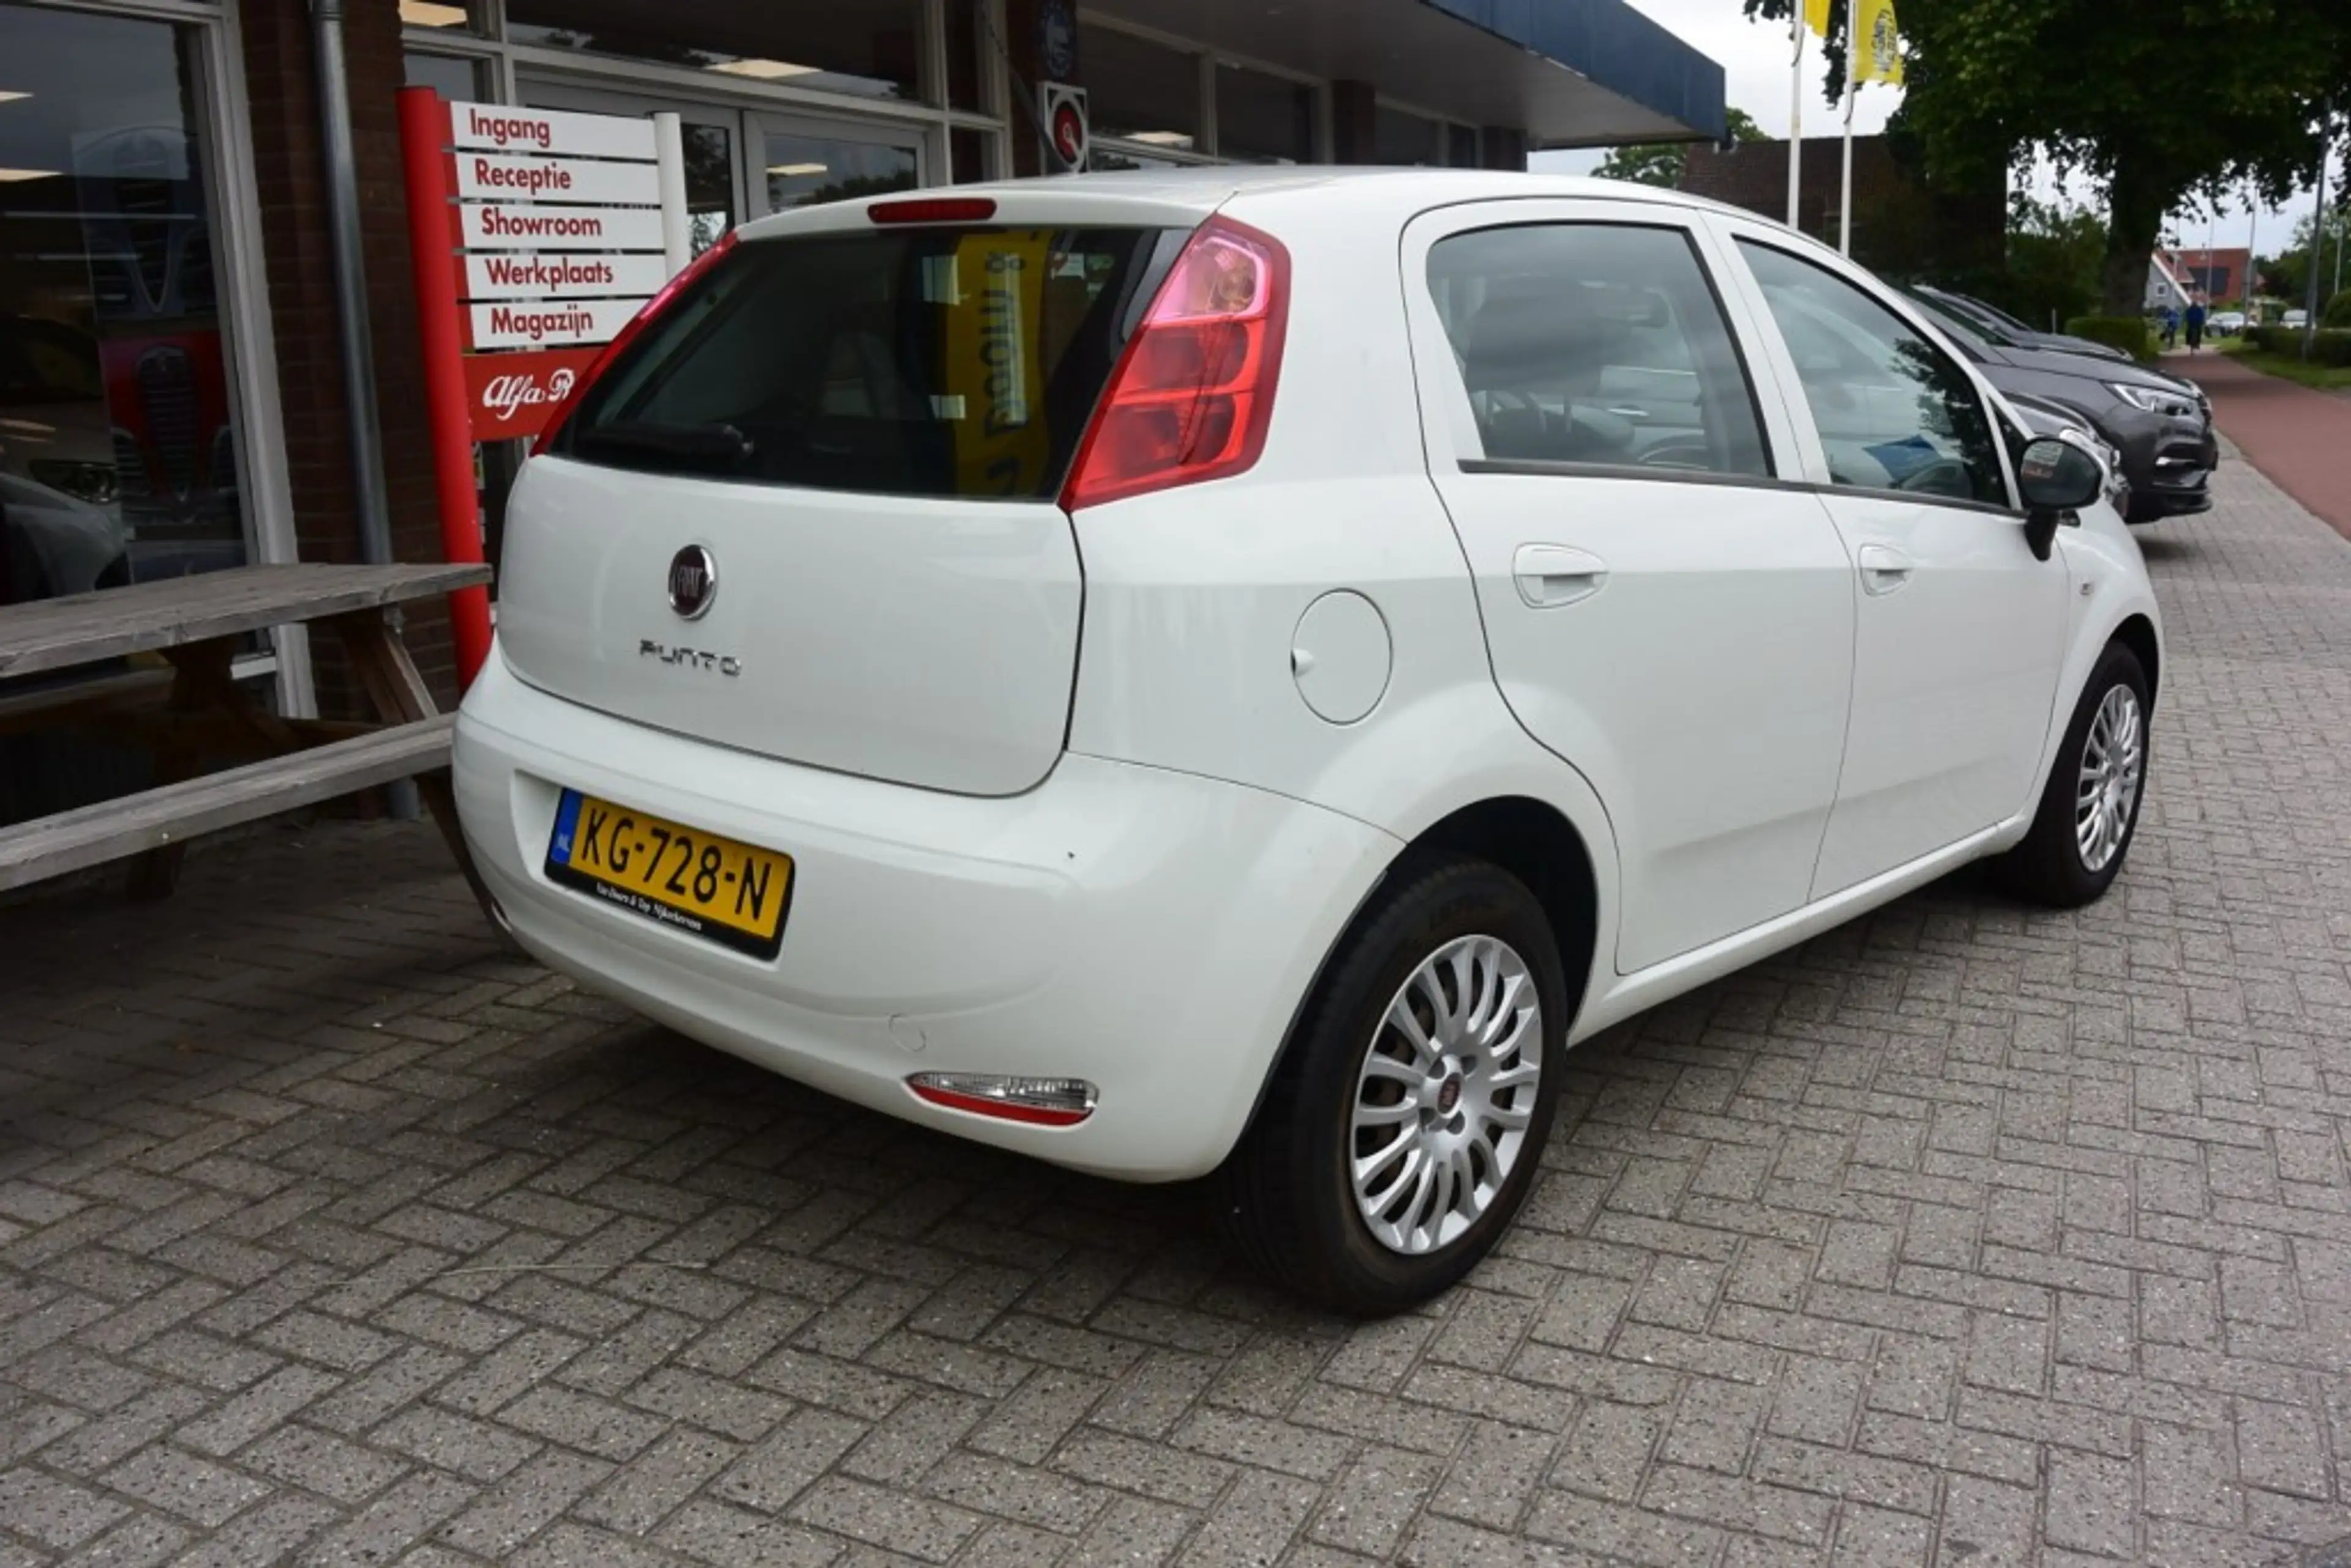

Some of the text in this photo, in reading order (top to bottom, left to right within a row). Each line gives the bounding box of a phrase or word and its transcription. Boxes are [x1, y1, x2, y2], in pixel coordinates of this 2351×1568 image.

[470, 108, 551, 148] Ingang
[474, 158, 572, 195] Receptie
[481, 208, 602, 236] Showroom
[485, 257, 613, 292] Werkplaats
[491, 304, 593, 340] Magazijn
[482, 375, 546, 421] Alfa
[640, 639, 741, 677] PUNTO
[581, 808, 773, 921] KG-728-N
